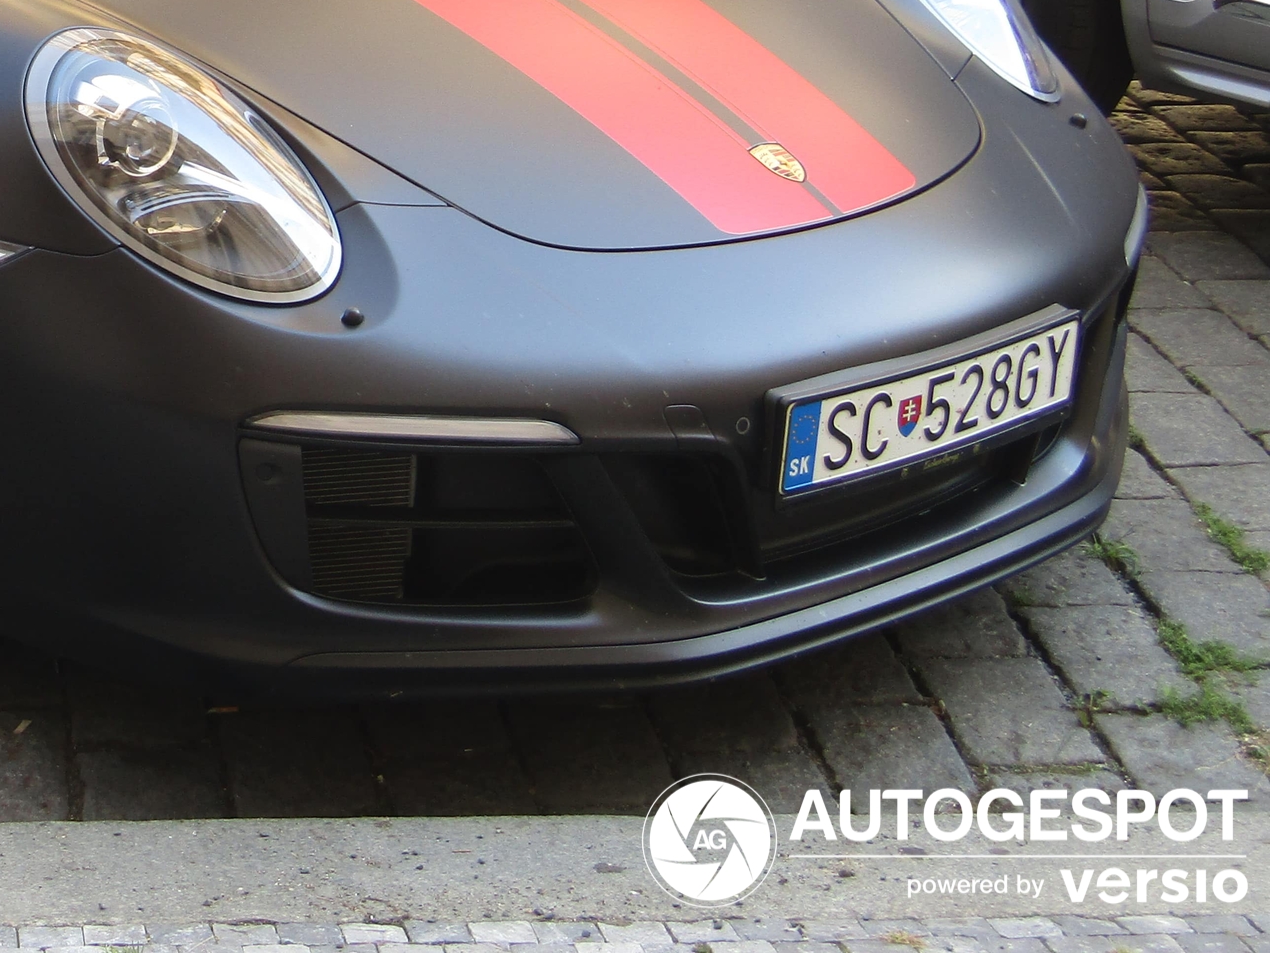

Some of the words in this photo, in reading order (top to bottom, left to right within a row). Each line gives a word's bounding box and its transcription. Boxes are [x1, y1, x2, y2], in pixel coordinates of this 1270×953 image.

[823, 391, 893, 470] SC
[923, 328, 1070, 442] 528GY
[789, 455, 810, 476] SK
